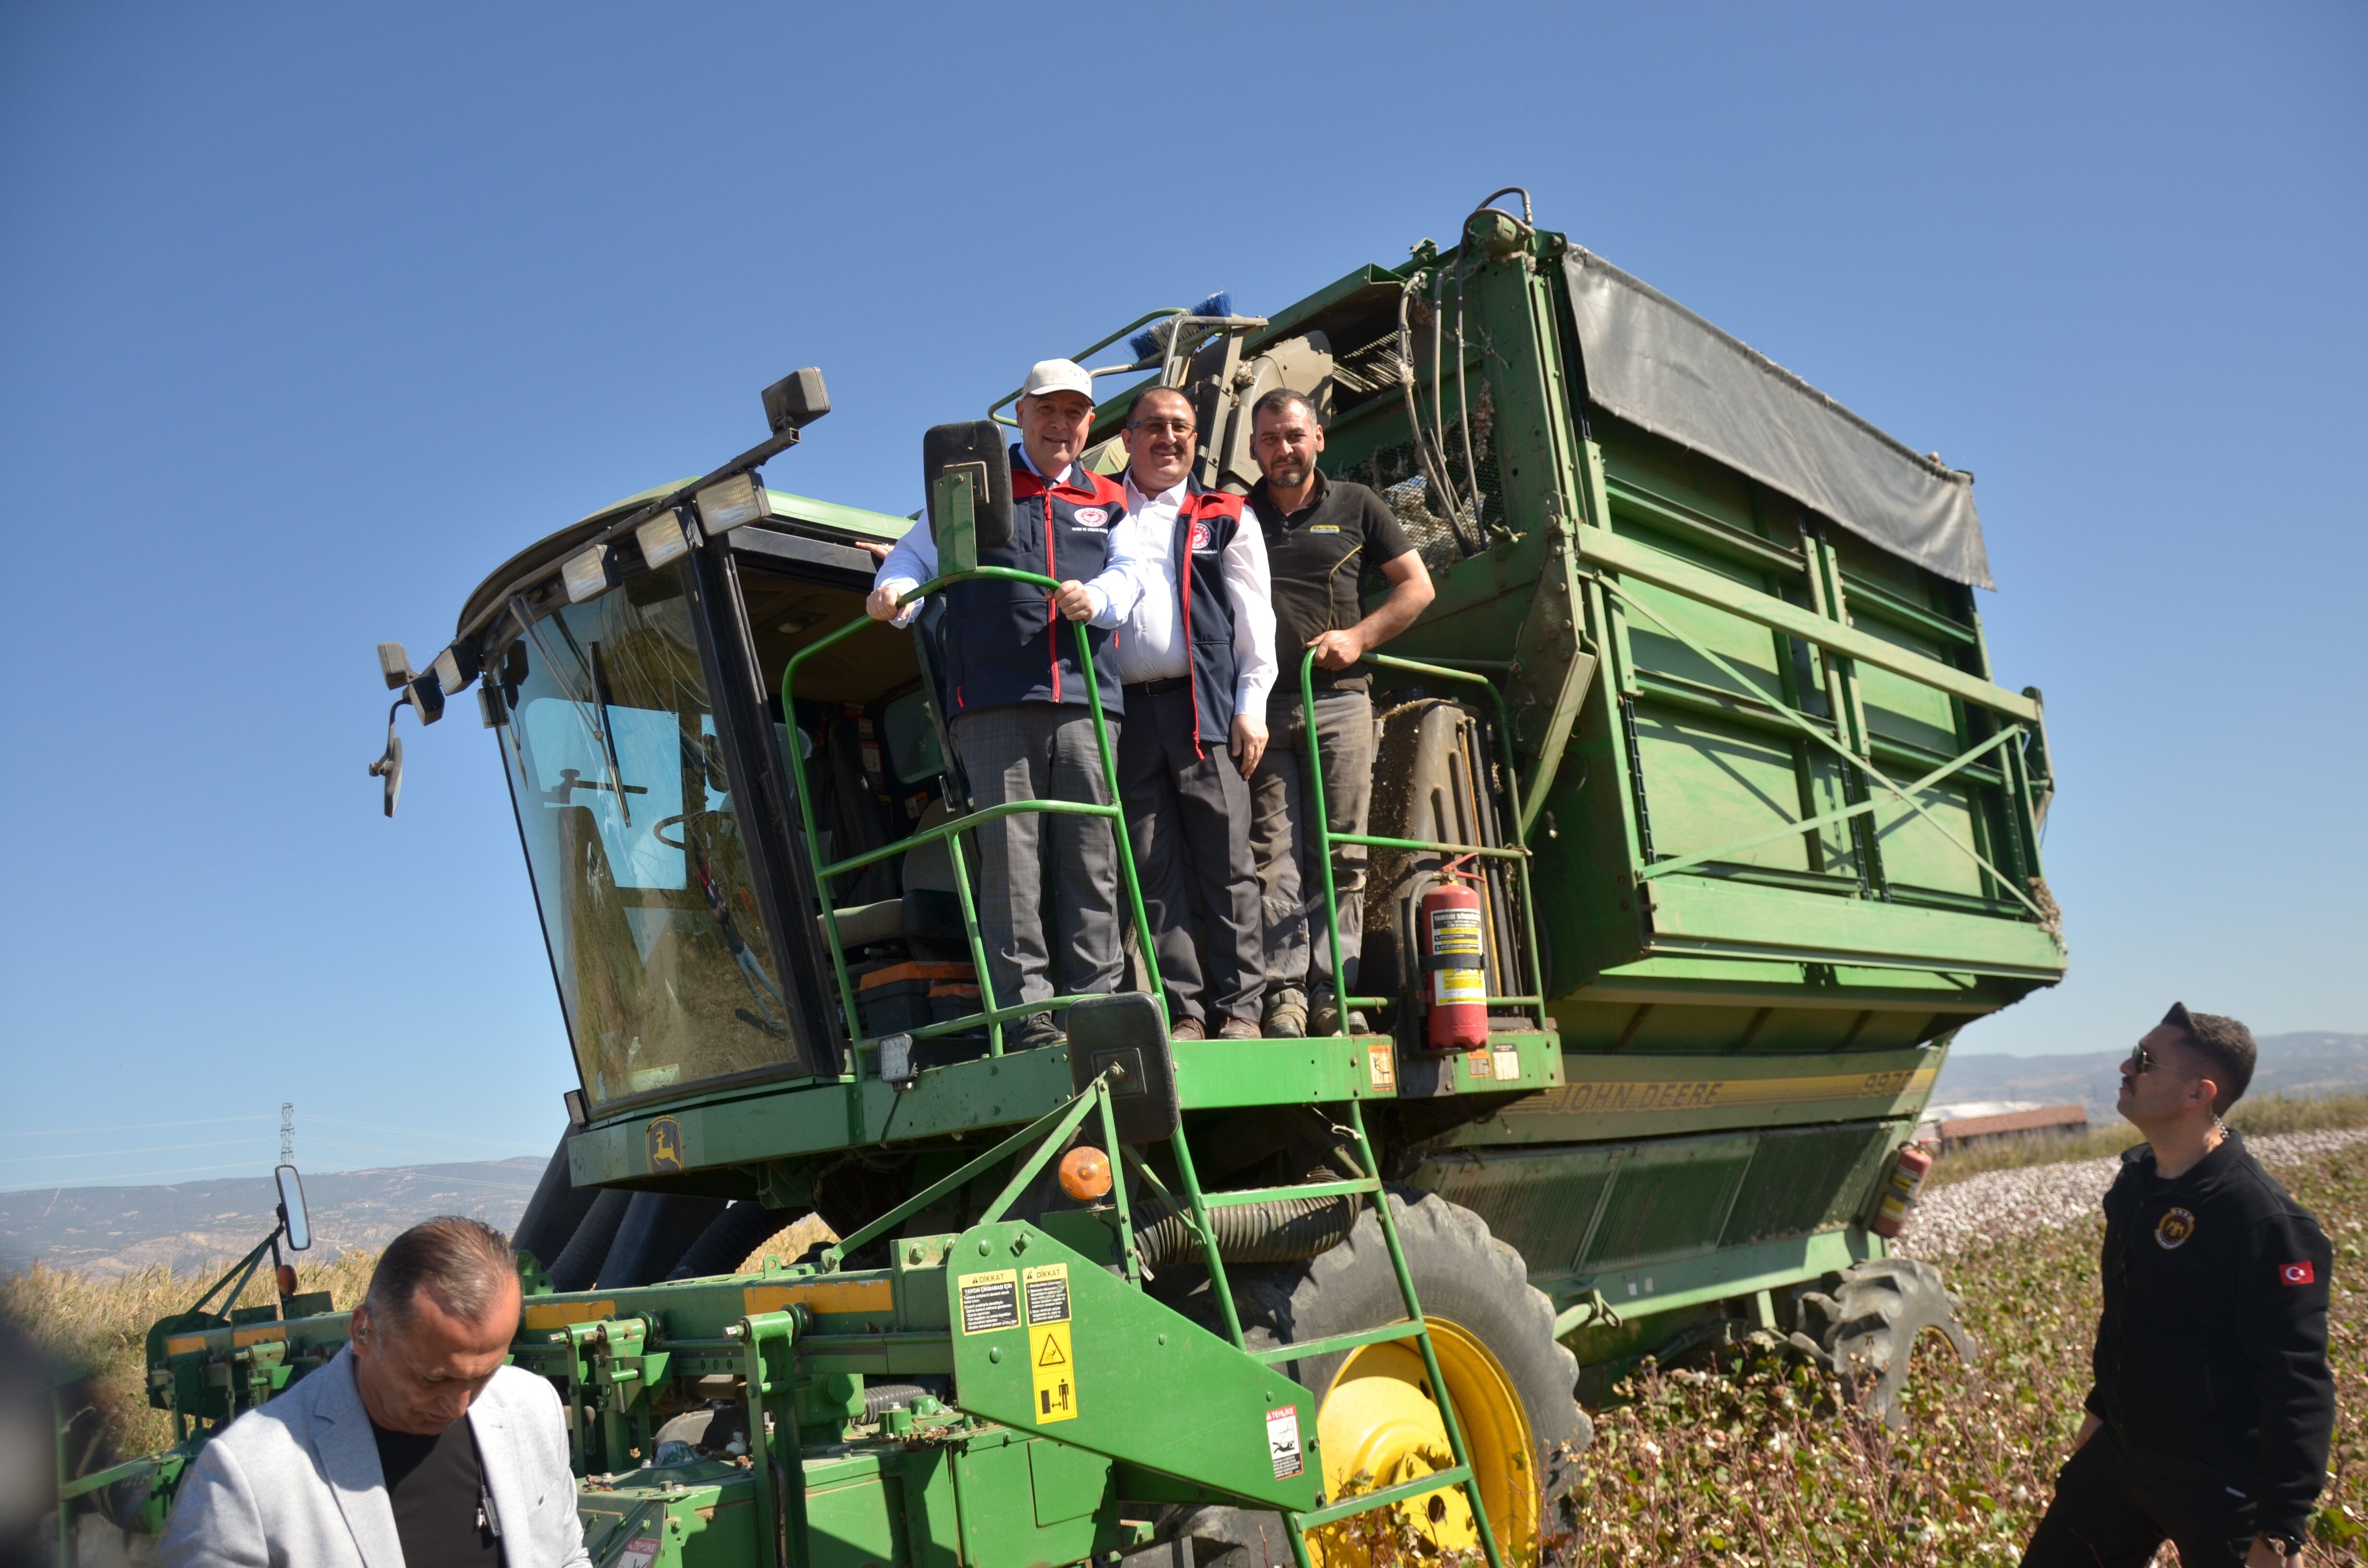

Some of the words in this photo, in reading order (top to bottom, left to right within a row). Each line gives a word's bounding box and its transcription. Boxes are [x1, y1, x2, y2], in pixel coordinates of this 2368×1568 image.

[1550, 1084, 1635, 1113] JOHN
[1638, 1083, 1727, 1110] DEERE
[979, 1274, 1004, 1283] DİKKAT
[1037, 1269, 1061, 1278] DİKKAT
[1271, 1407, 1294, 1419] TEHLİKE
